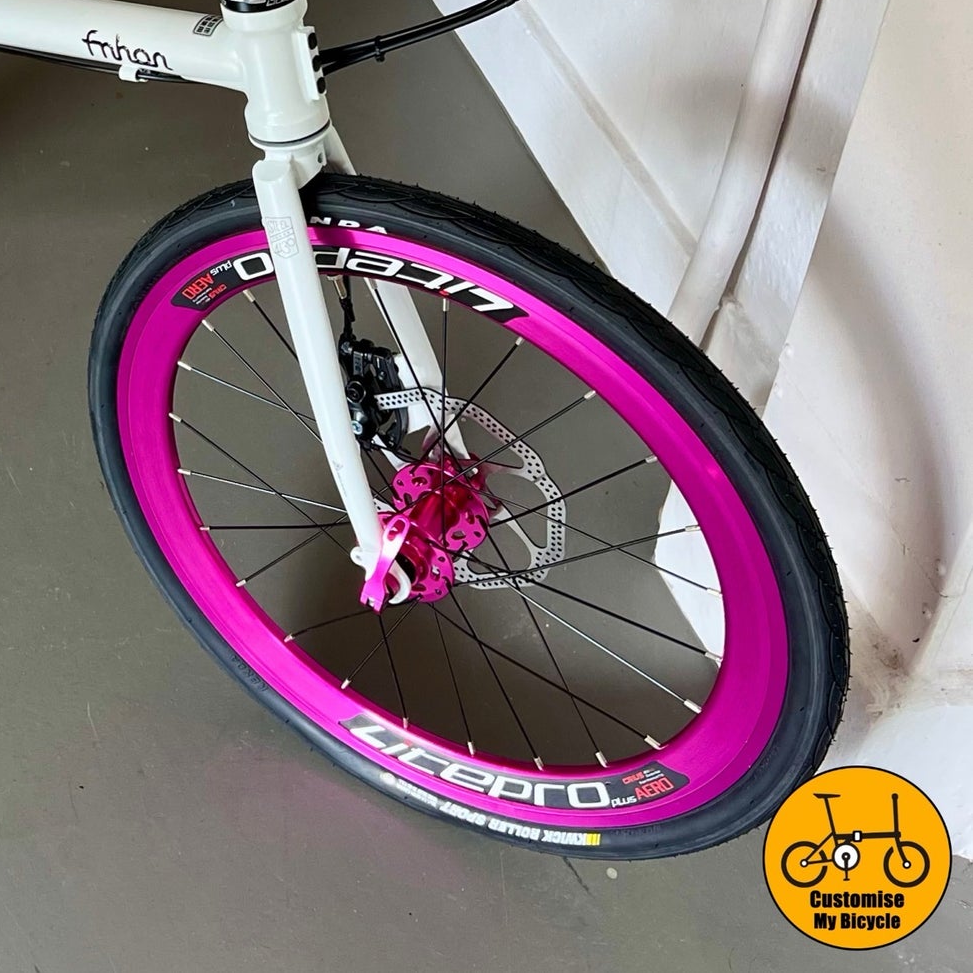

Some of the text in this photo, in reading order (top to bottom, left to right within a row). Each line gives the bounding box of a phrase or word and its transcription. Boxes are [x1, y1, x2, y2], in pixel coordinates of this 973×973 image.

[634, 777, 674, 800] AERO
[439, 801, 487, 826] SPORT
[488, 818, 540, 840] ROLLER
